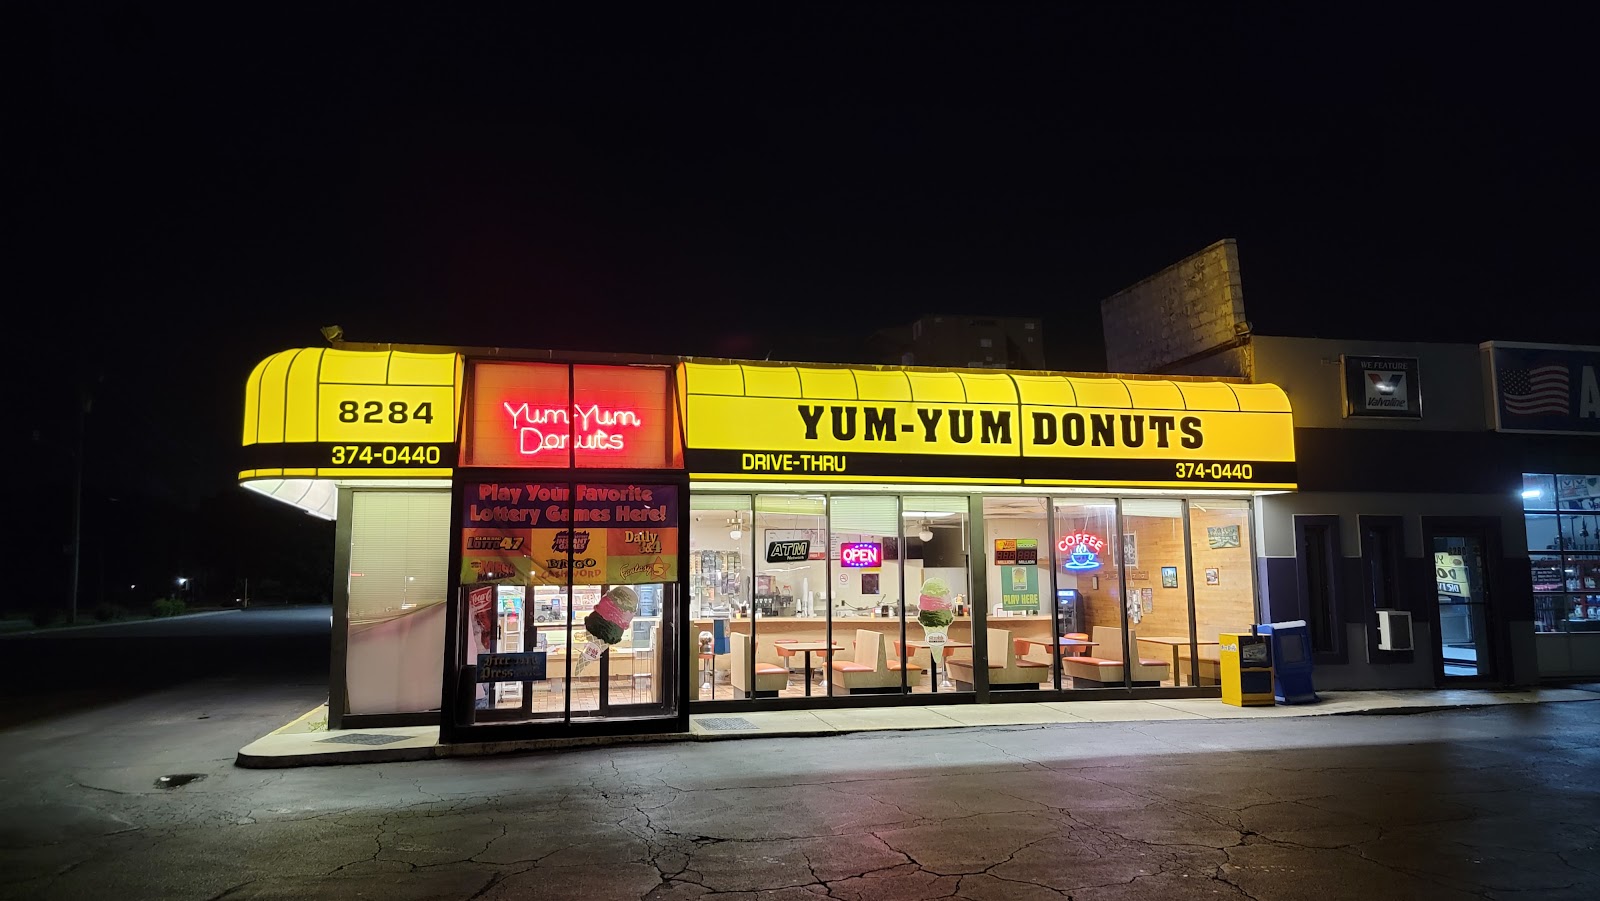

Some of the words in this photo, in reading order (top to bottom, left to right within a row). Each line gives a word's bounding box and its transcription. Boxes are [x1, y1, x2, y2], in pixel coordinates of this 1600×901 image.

[1368, 397, 1406, 407] Valvoline
[338, 400, 434, 424] 8284
[798, 405, 1012, 444] YUM-YUM
[1032, 412, 1203, 449] DONUTS
[520, 427, 624, 454] Donuts
[331, 445, 440, 465] 374-0440
[742, 453, 846, 472] DRIVE-THRU
[1175, 462, 1253, 479] 374-0440
[479, 484, 522, 504] Play
[526, 484, 570, 501] Your
[576, 484, 653, 501] Favorite
[470, 504, 541, 525] Lottery
[546, 505, 611, 522] Games
[615, 505, 666, 522] Here!
[625, 530, 658, 544] Daily
[1058, 533, 1103, 551] COFFEE
[770, 541, 807, 557] ATM
[843, 547, 877, 562] OPEN
[1003, 594, 1020, 605] PLAY
[1021, 593, 1038, 604] HERE
[480, 667, 514, 680] Press
